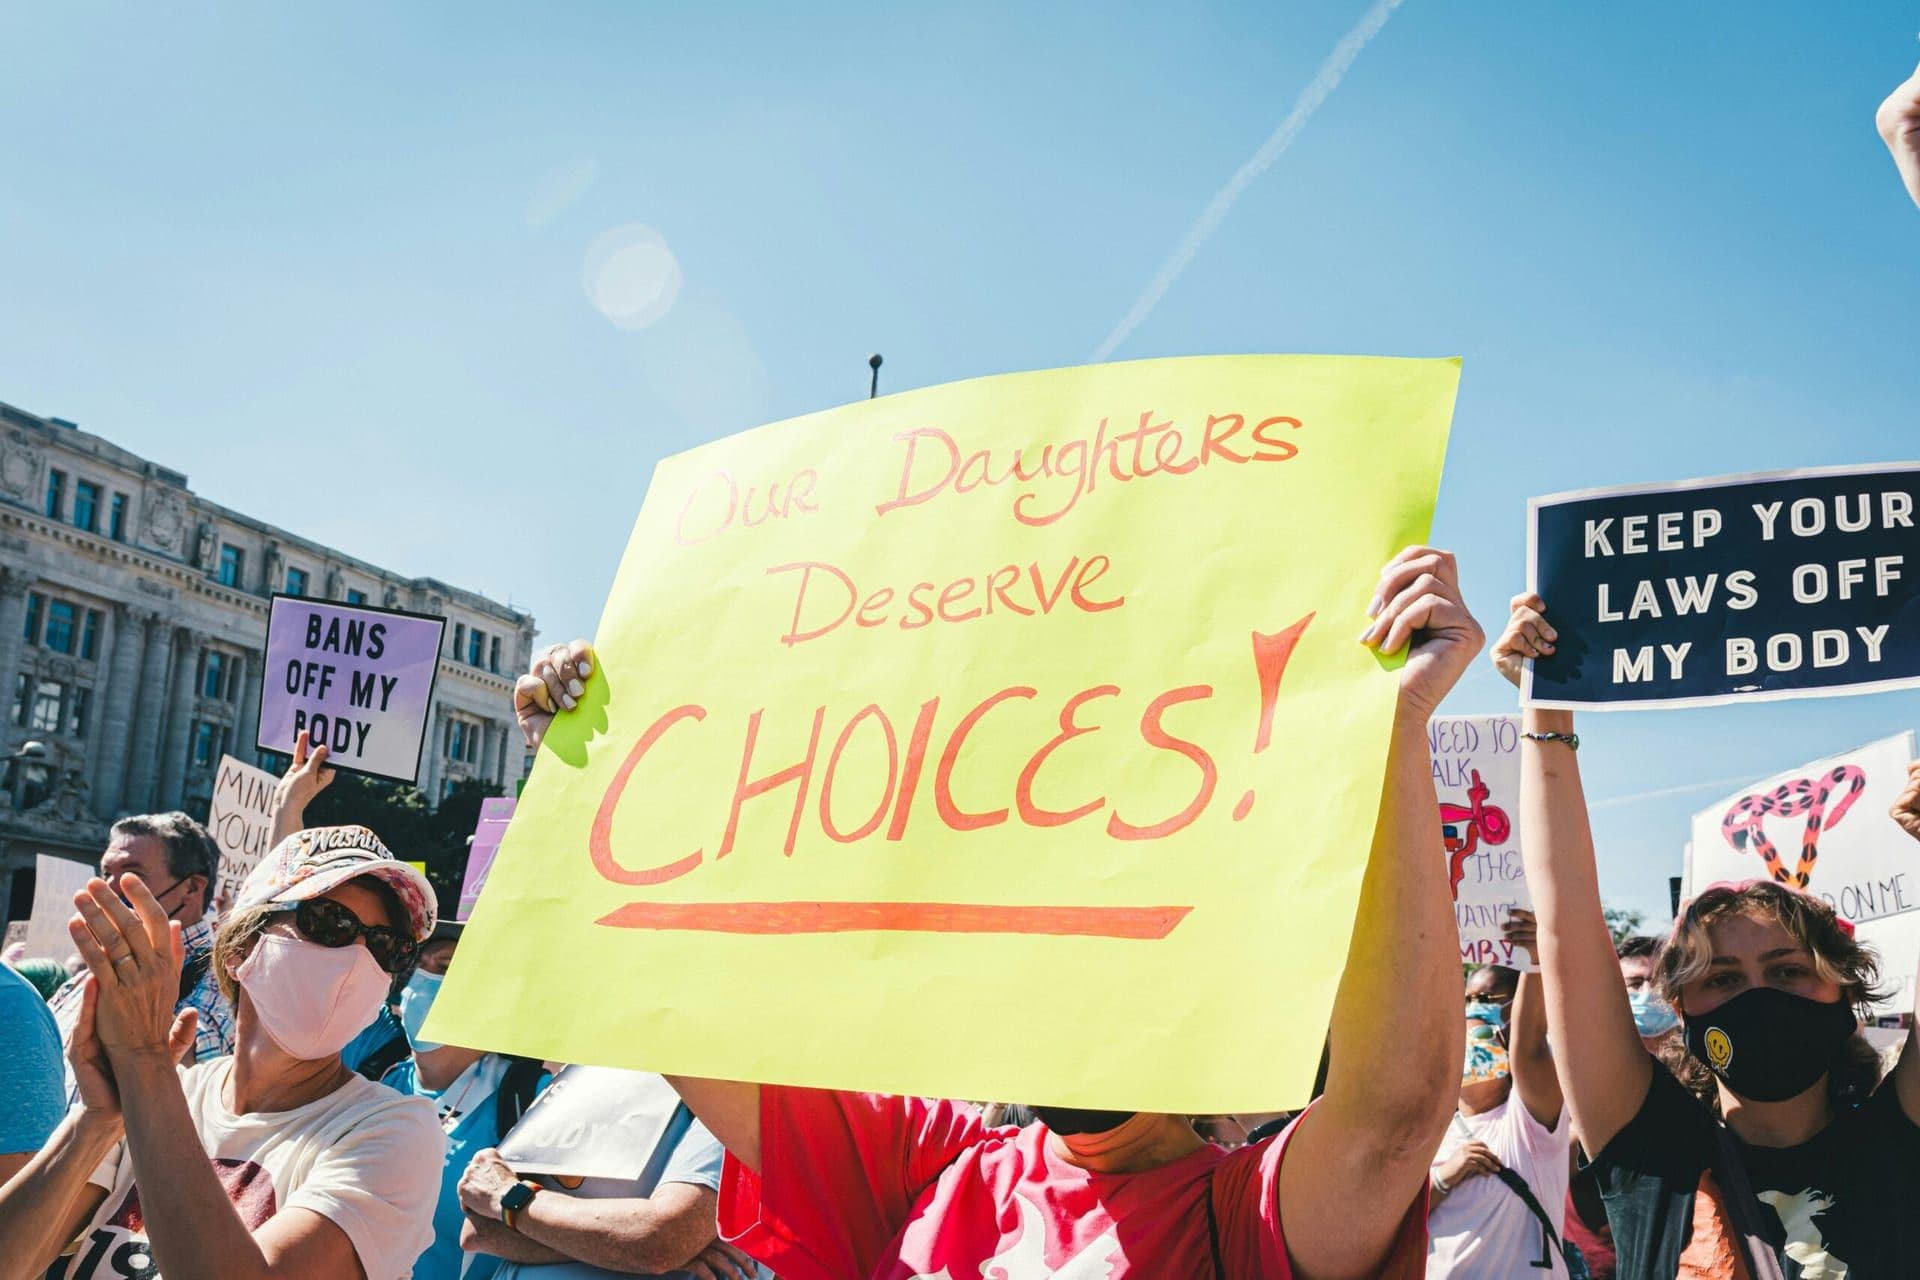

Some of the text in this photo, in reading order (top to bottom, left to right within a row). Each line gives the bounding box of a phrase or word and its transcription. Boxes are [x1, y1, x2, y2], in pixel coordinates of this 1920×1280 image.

[1584, 491, 1914, 558] KEEP YOUR
[1598, 555, 1904, 623] LAWS OFF
[305, 613, 388, 660] BANS
[1612, 624, 1890, 684] MY BODY
[286, 659, 398, 712] OFF MY
[293, 709, 372, 758] BODY
[589, 610, 1317, 886] CHOICES!
[1487, 717, 1517, 754] TO
[1432, 757, 1471, 787] ALK
[1469, 849, 1524, 883] THE
[1841, 882, 1875, 920] ON
[1879, 873, 1911, 913] ME
